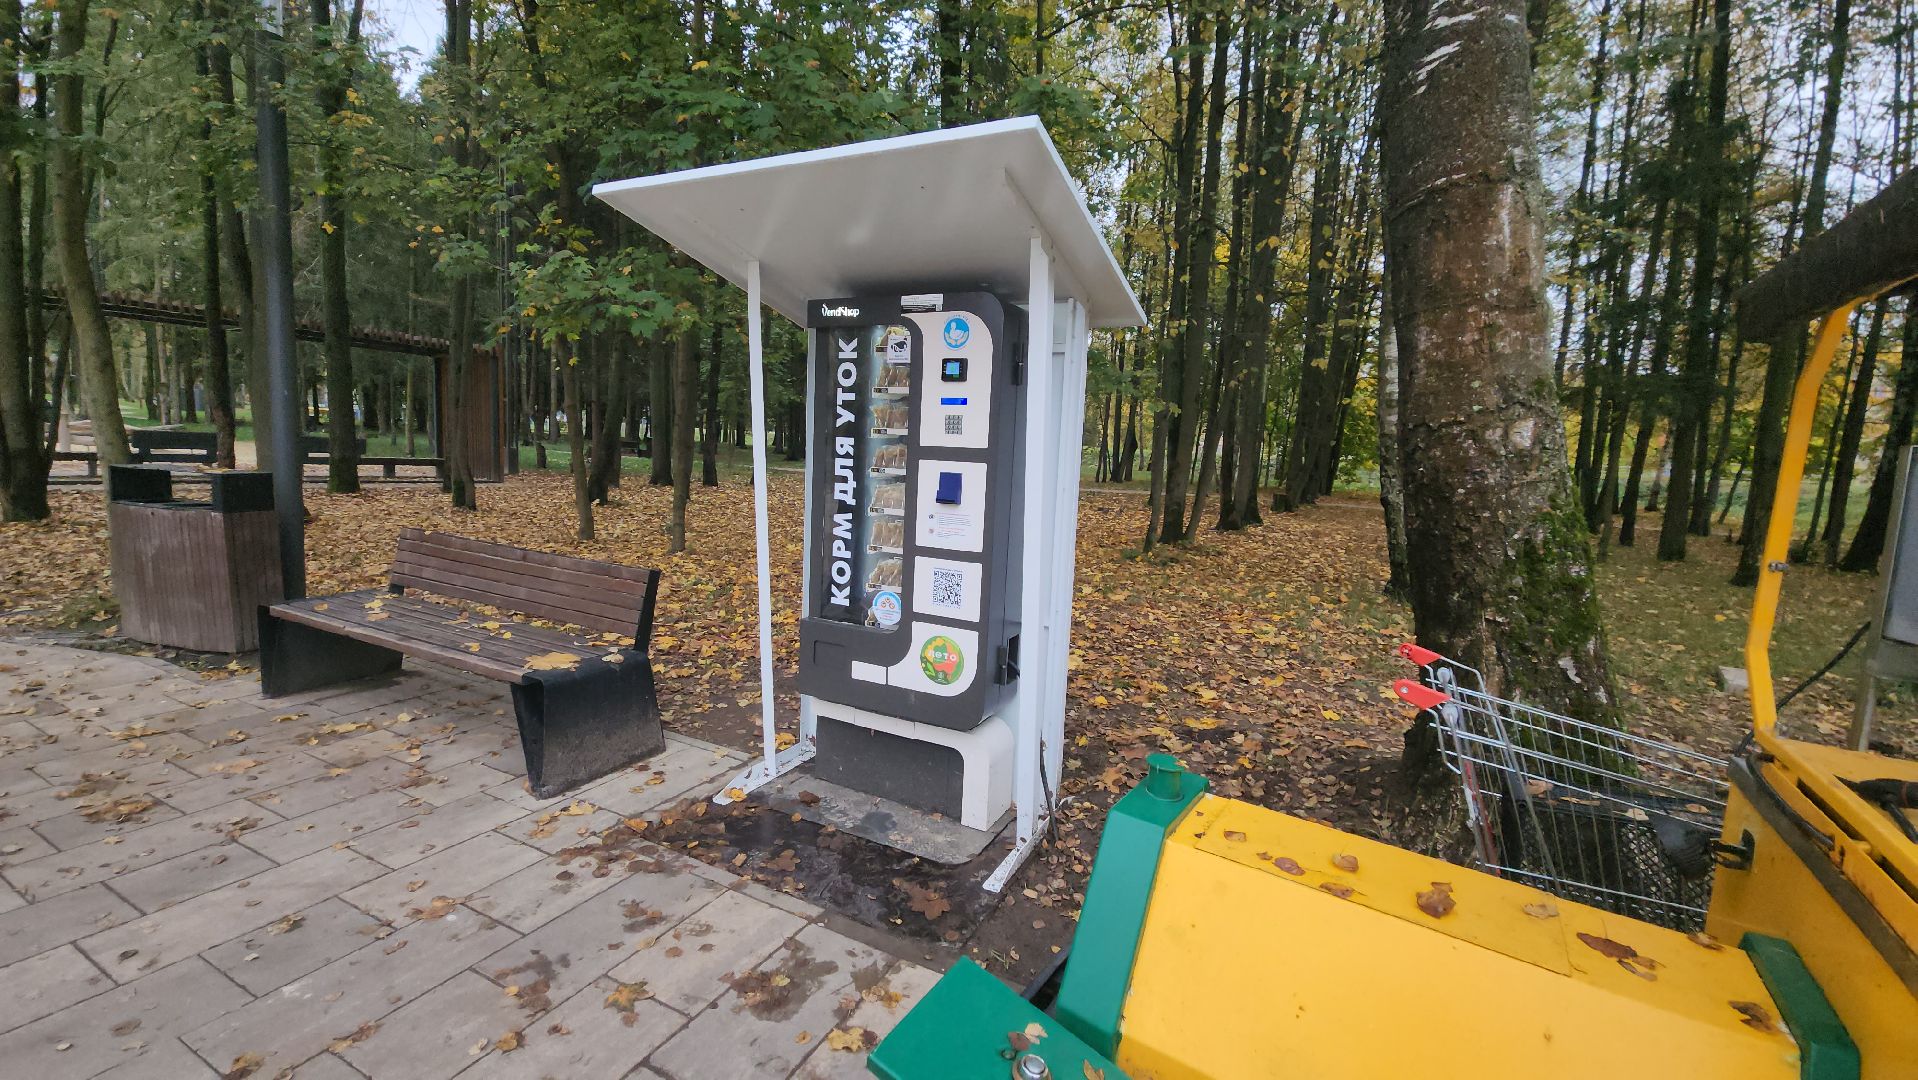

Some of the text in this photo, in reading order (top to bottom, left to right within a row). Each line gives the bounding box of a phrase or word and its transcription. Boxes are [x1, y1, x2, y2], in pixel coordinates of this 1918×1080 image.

[830, 337, 858, 607] КОРМ ДЛЯ УТОК
